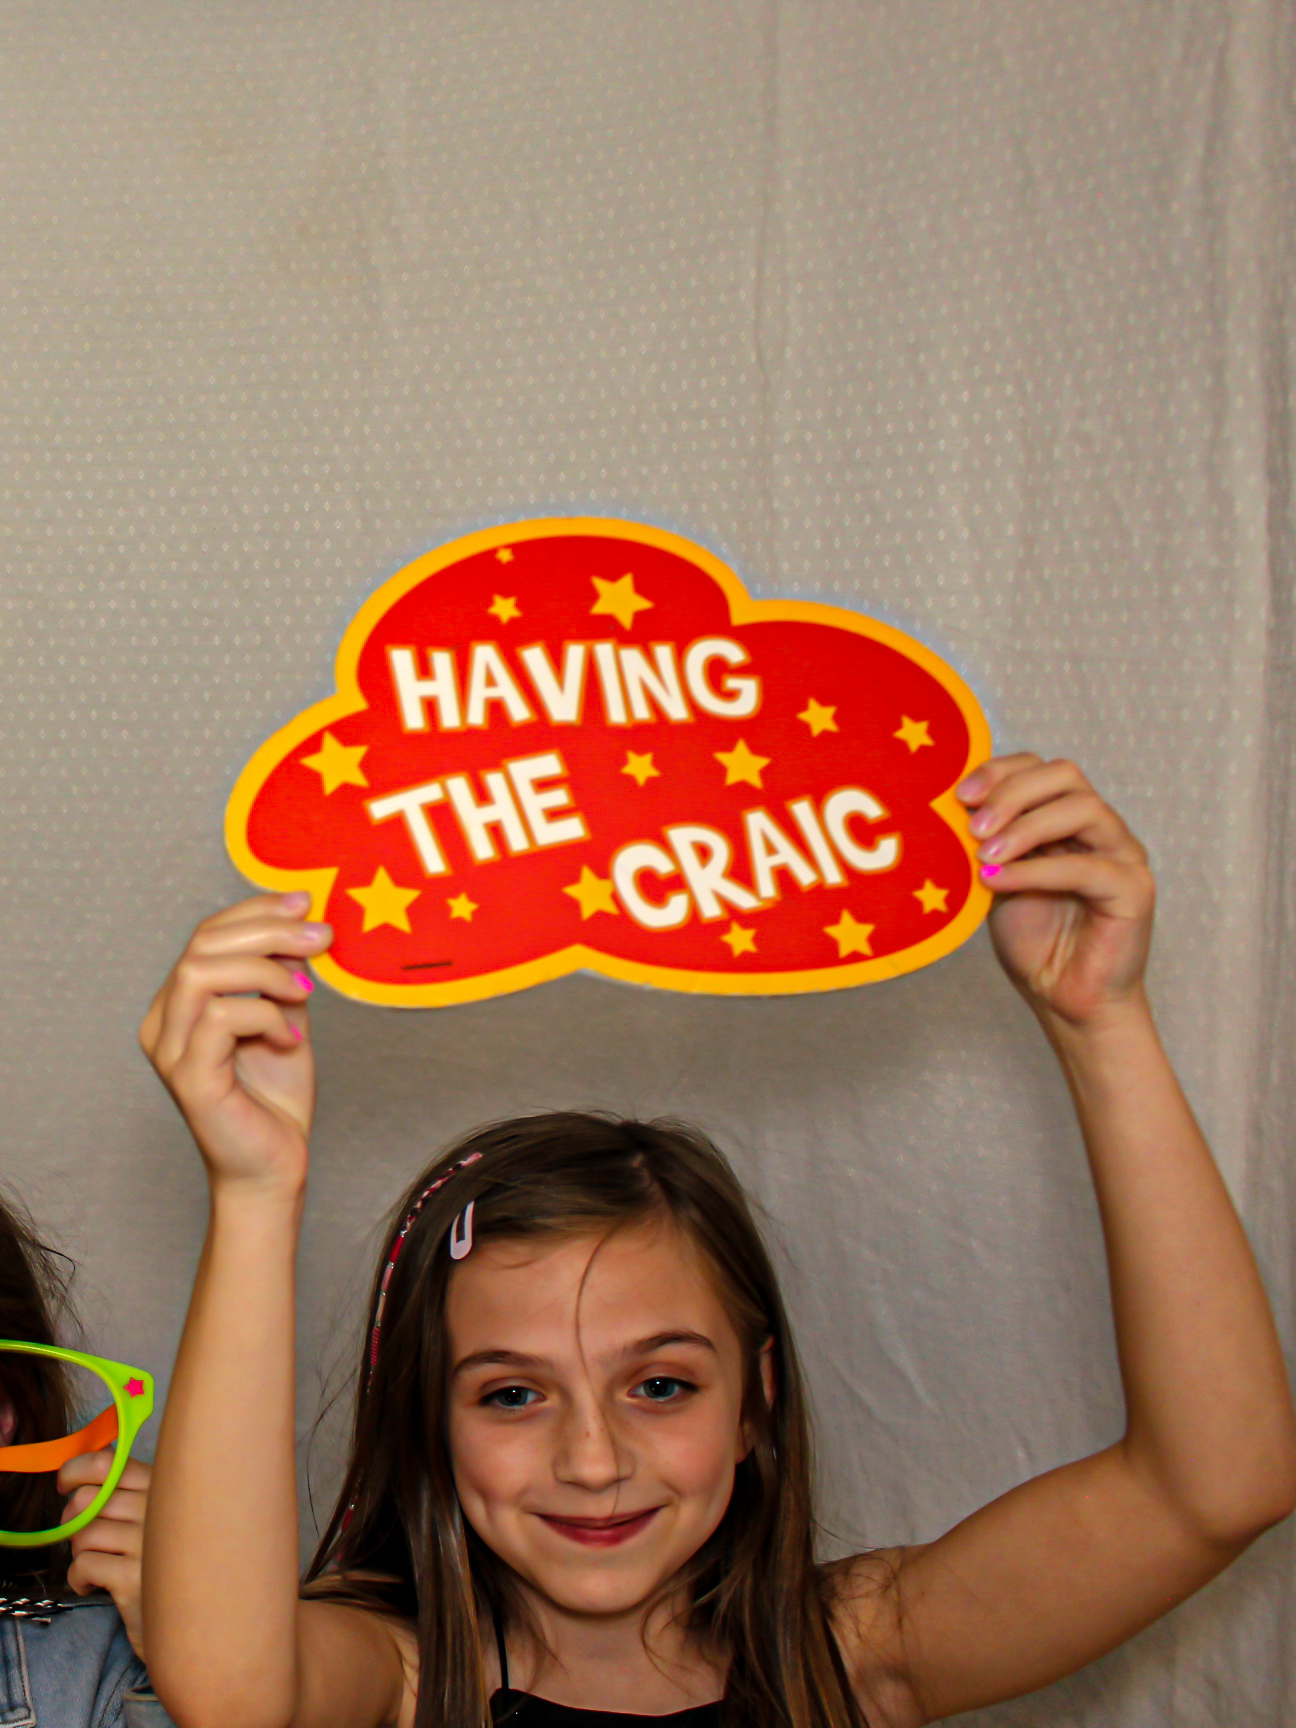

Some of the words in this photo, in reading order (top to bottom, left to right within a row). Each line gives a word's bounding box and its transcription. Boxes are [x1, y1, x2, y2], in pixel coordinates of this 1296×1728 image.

[388, 638, 760, 731] HAVING
[368, 753, 586, 875] THE
[612, 788, 898, 929] CRAIC
